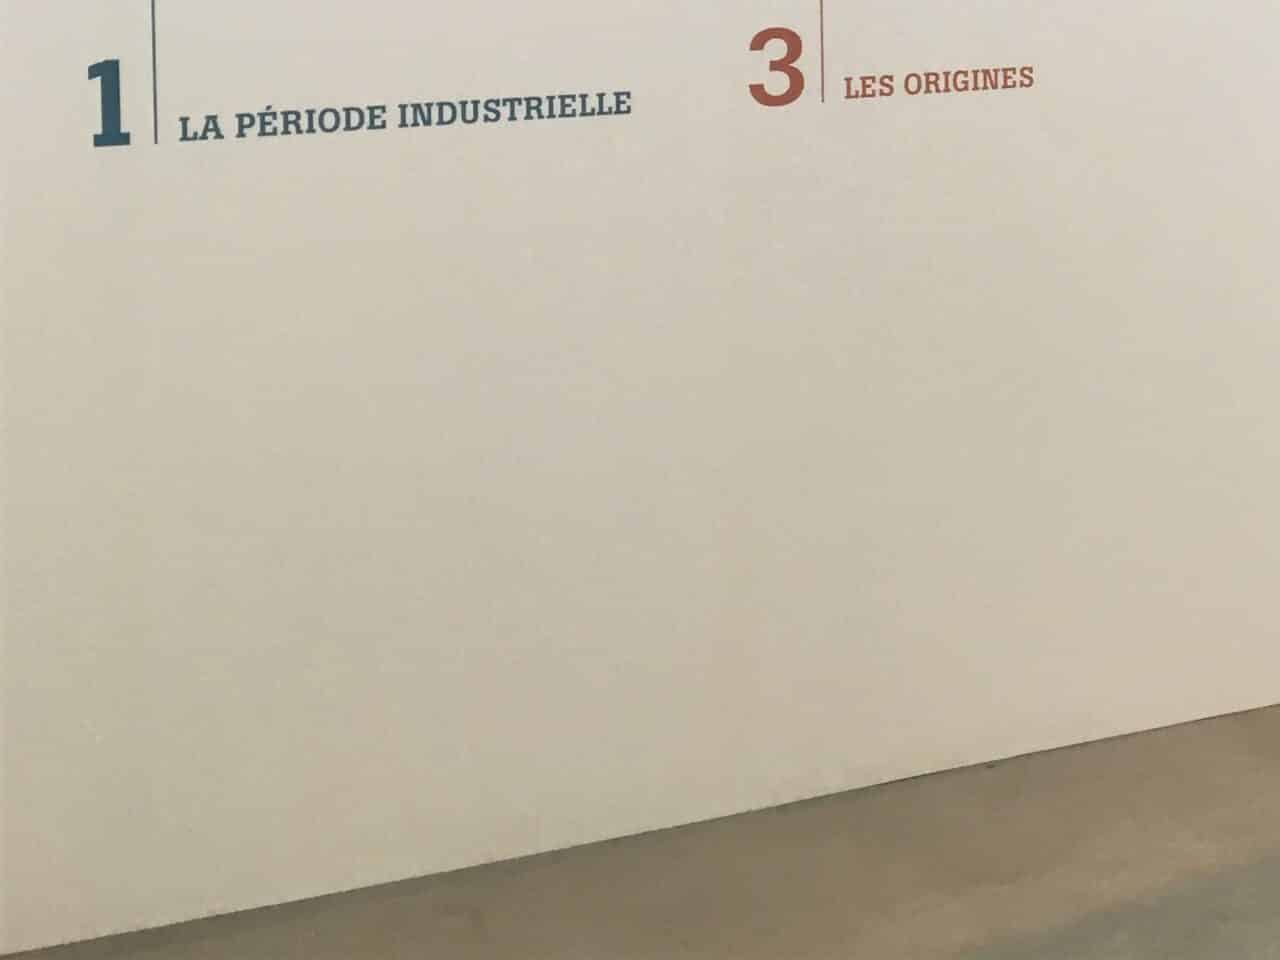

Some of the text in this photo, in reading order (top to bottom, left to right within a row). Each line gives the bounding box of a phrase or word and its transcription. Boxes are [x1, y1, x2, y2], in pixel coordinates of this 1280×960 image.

[748, 26, 805, 108] 3
[843, 66, 1035, 100] LES ORIGINES
[87, 58, 132, 148] 1
[178, 90, 633, 143] LA PÉRIODE INDUSTRIELLE
